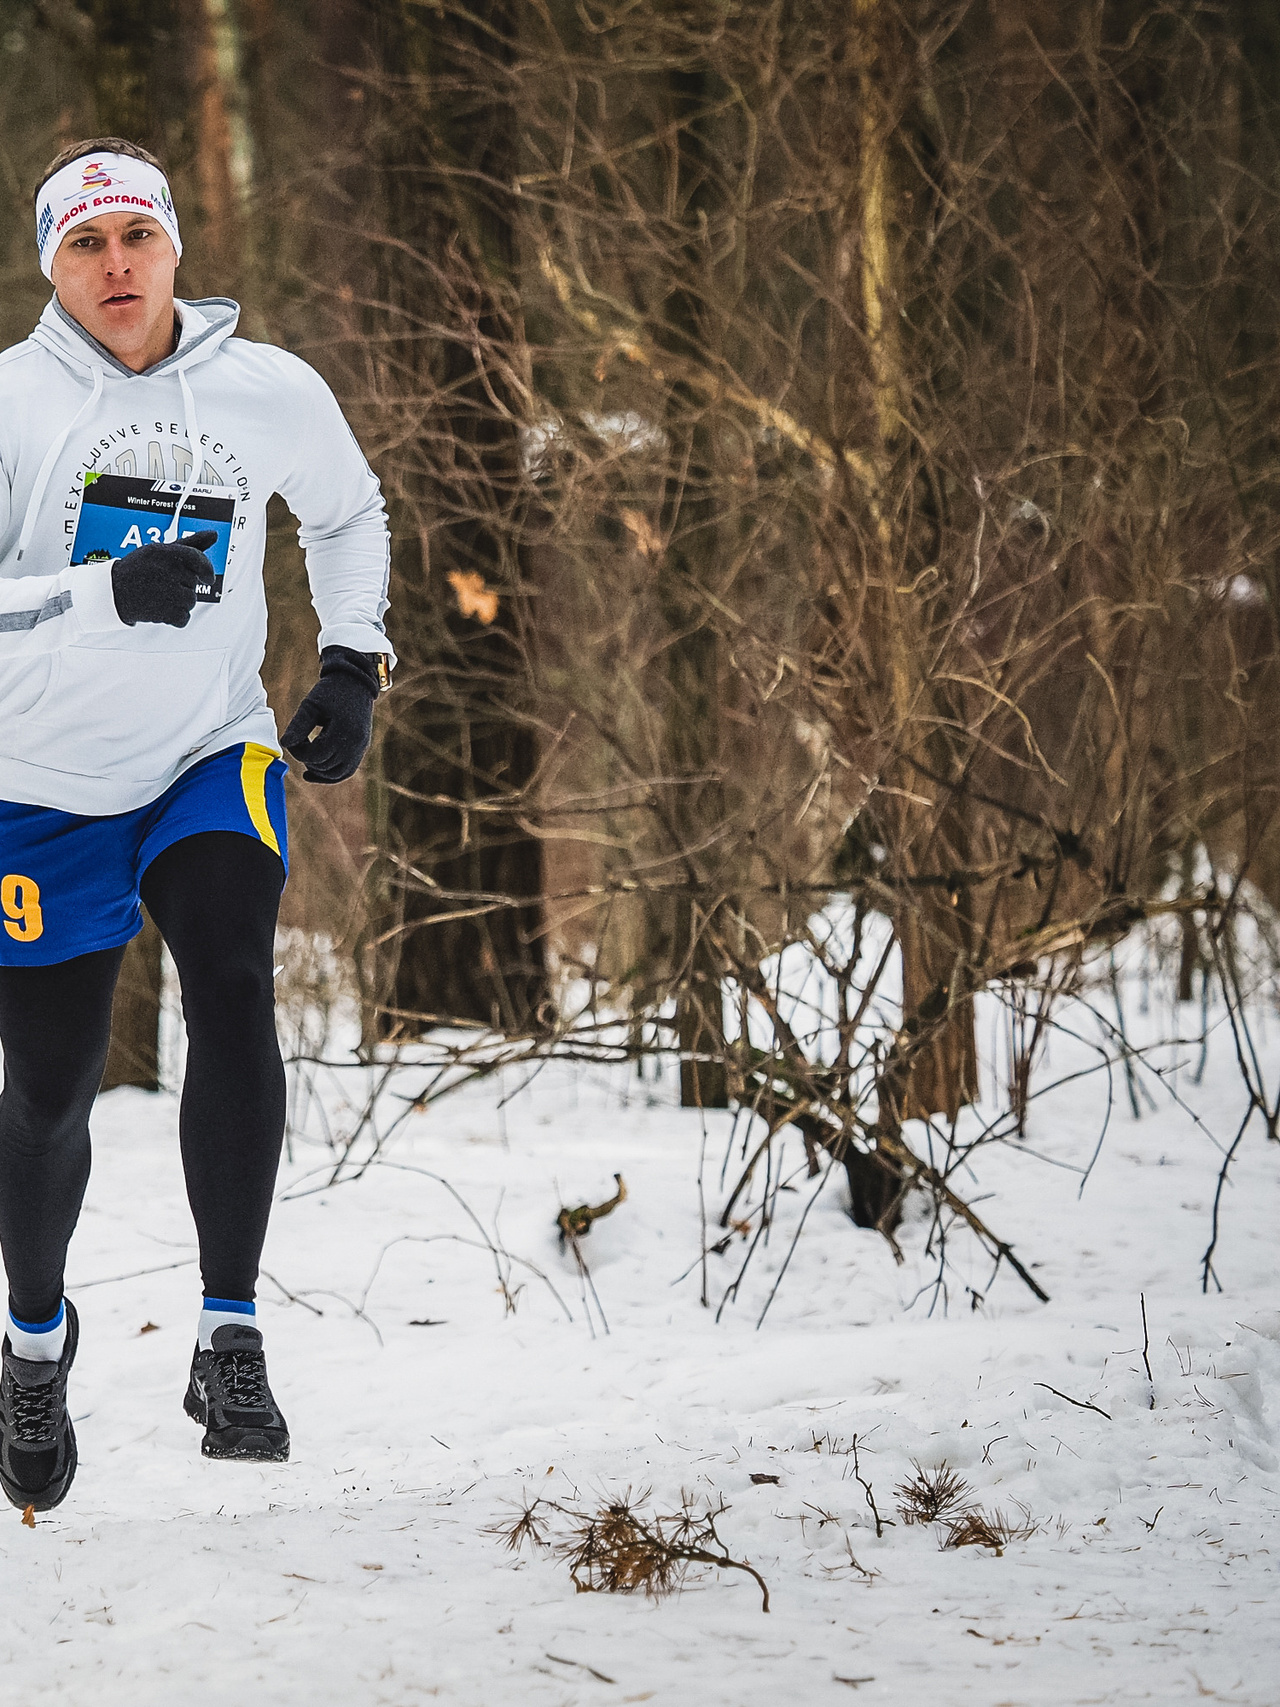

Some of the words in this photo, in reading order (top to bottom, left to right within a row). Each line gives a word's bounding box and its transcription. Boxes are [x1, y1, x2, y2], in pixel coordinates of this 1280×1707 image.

[127, 496, 150, 506] Winter
[151, 498, 174, 509] Forest
[175, 501, 196, 511] Coss
[119, 524, 197, 550] A3
[195, 584, 211, 595] KM
[0, 873, 44, 943] 9
